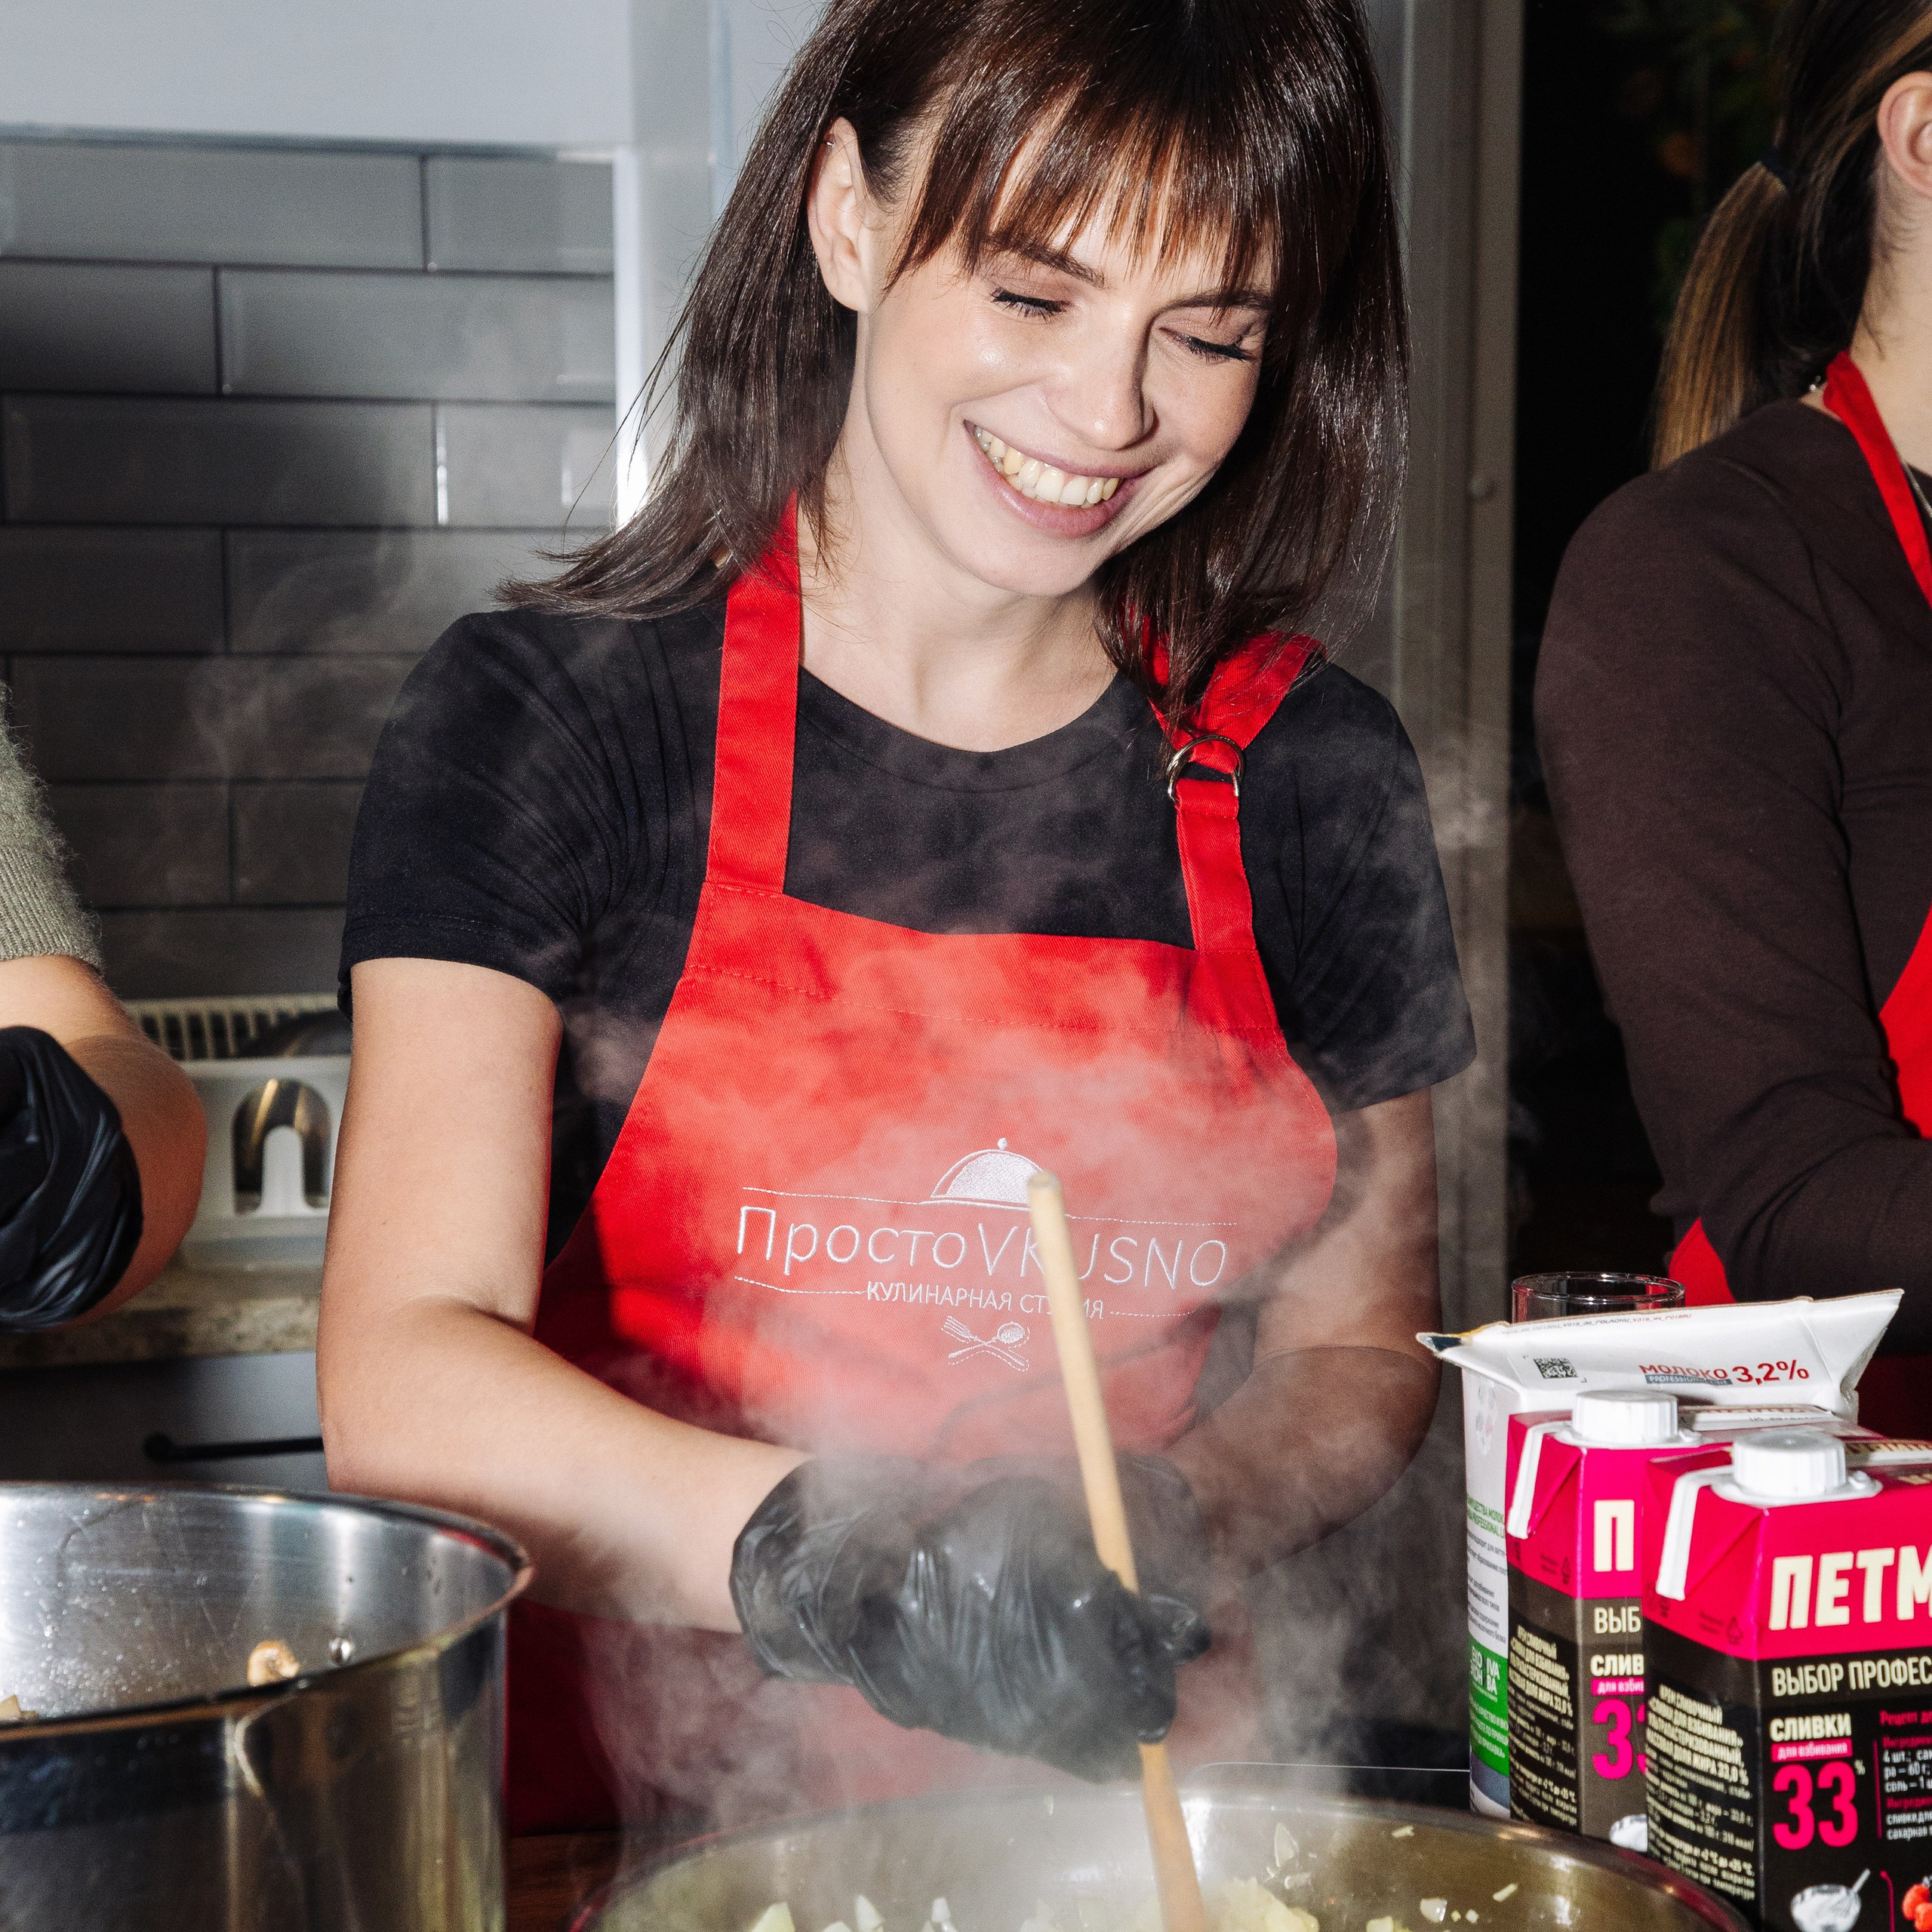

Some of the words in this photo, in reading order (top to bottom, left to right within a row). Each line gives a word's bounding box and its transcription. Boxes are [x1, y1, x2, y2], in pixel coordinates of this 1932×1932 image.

[867, 1281, 1012, 1311] КУЛИНАРНАЯ
[1638, 1364, 1728, 1380] МОЛОКО
[1732, 1359, 1810, 1385] 3,2%
[1593, 1499, 1635, 1572] П
[1768, 1544, 1932, 1631] ПЕТМ
[1594, 1606, 1641, 1634] ВЫБ
[1590, 1654, 1644, 1677] СЛИВ
[1771, 1663, 1844, 1697] ВЫБОР
[1848, 1656, 1932, 1690] ПРОФЕС
[1597, 1680, 1617, 1694] для
[1592, 1698, 1646, 1780] 3
[1770, 1712, 1852, 1742] СЛИВКИ
[1777, 1746, 1798, 1761] для
[1798, 1741, 1848, 1758] взбивания
